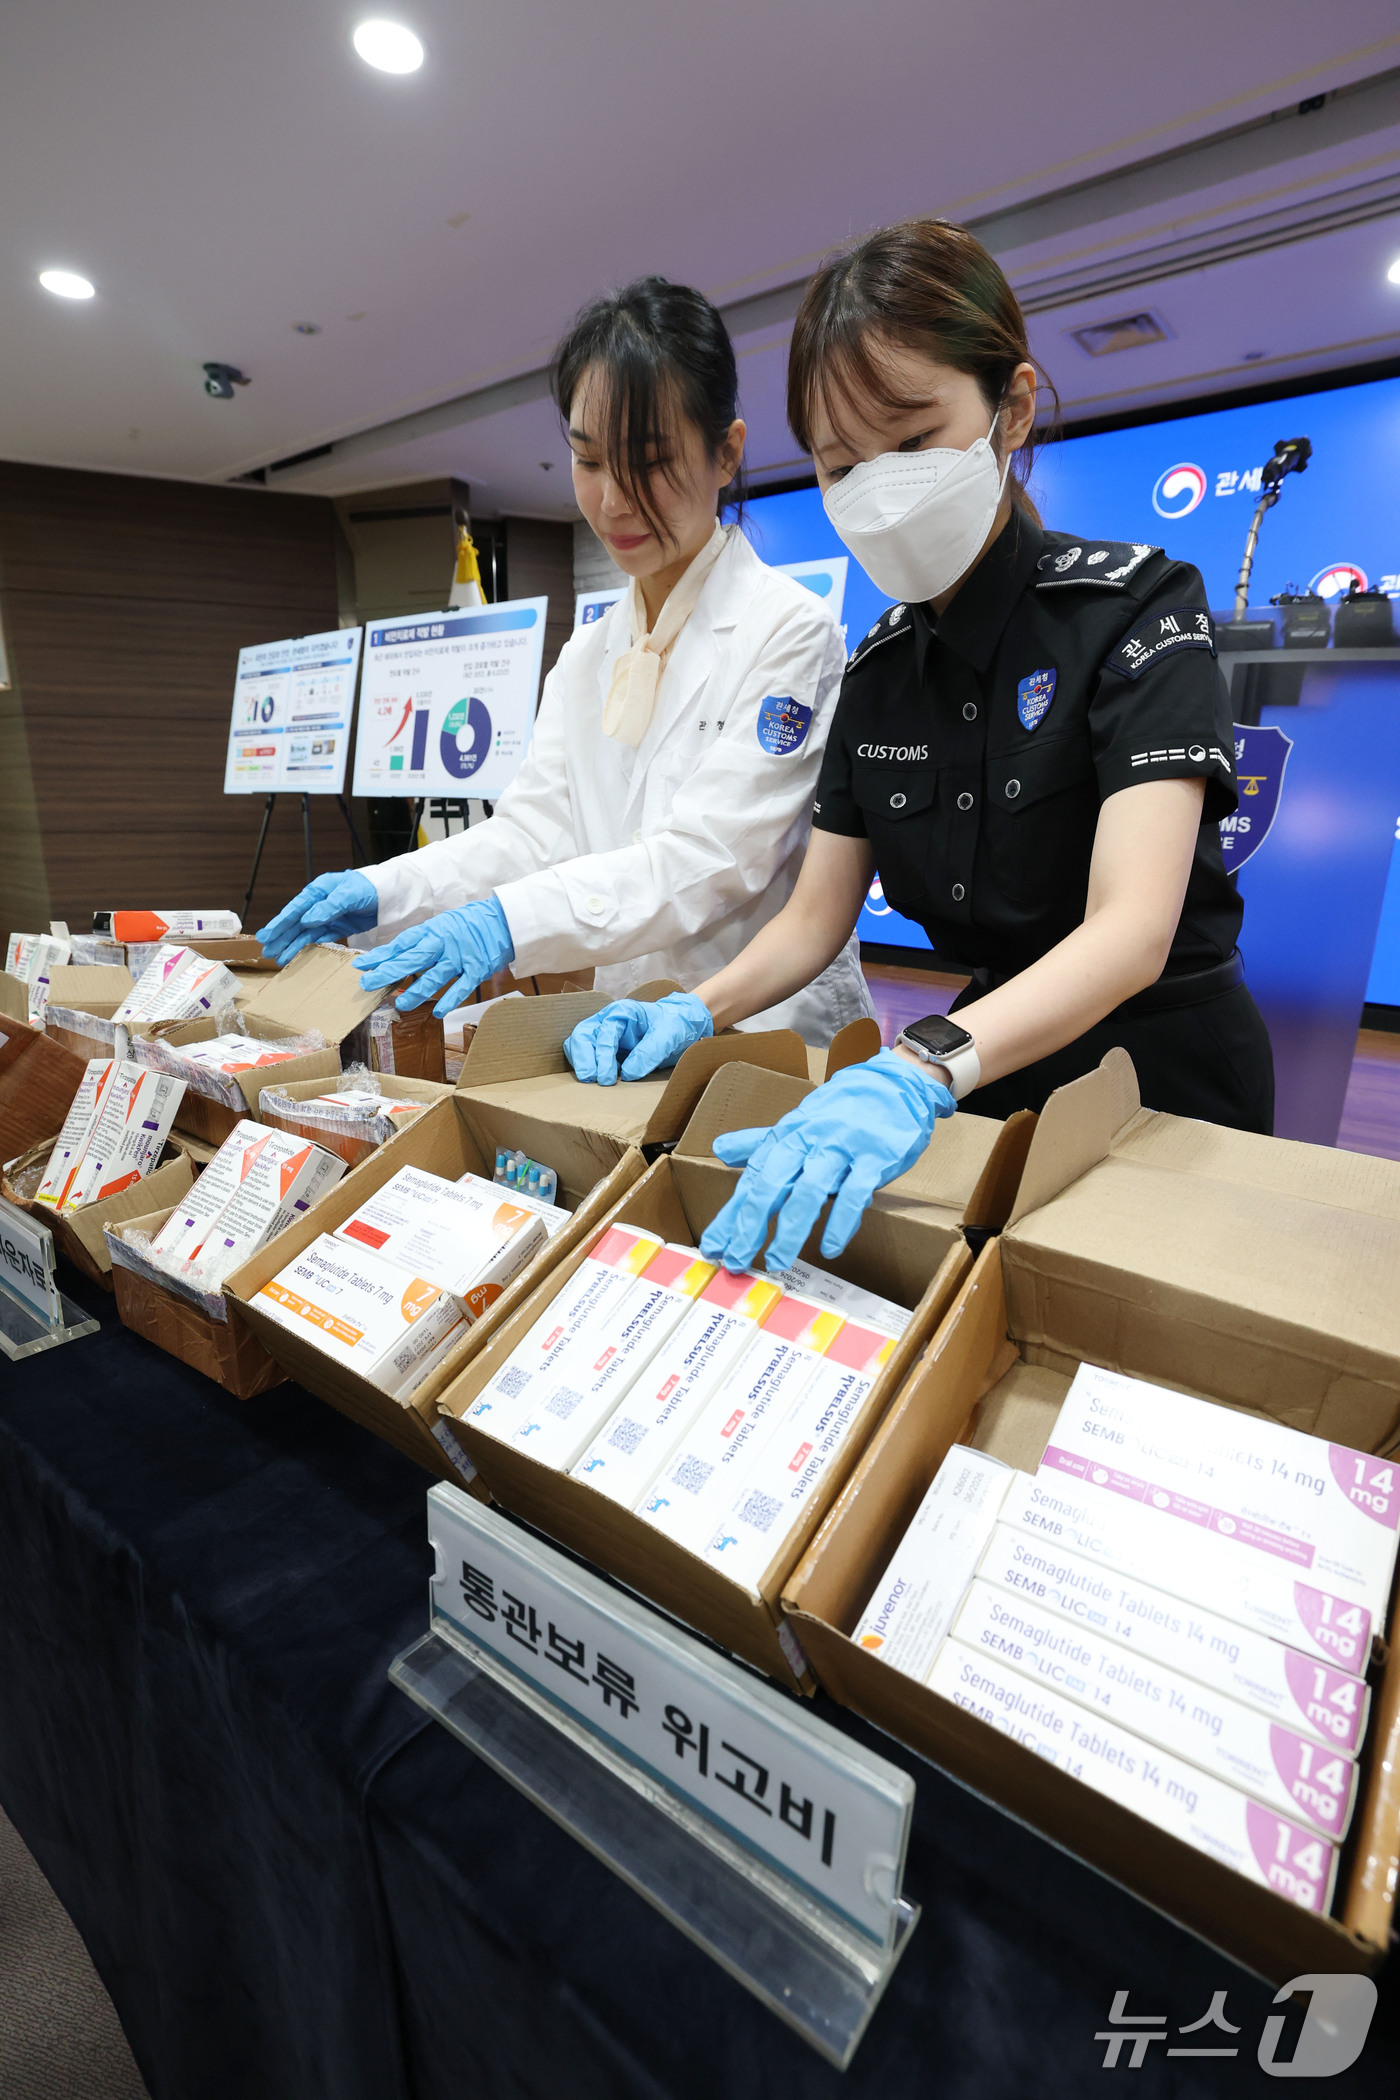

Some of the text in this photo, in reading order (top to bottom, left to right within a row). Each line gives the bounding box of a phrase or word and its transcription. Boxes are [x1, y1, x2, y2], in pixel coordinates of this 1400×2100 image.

[373, 633, 378, 644] 1
[1130, 649, 1156, 669] KOREA
[1155, 633, 1192, 650] CUSTOMS
[1029, 672, 1048, 686] 관세청
[776, 701, 799, 715] 관세청
[1022, 699, 1049, 715] CUSTOMS
[1027, 694, 1046, 706] KOREA
[1025, 708, 1045, 721] SERVICE
[763, 728, 797, 741] CUSTOMS
[769, 721, 794, 734] KOREA
[765, 736, 792, 747] SERVICE
[857, 744, 929, 761] CUSTOMS
[130, 1133, 146, 1158] KwikPen
[135, 1134, 154, 1165] mounjaro
[267, 1140, 296, 1156] Tirzepatide
[284, 1165, 294, 1173] mg
[399, 1172, 443, 1194] Semaglutide
[438, 1187, 468, 1203] Tablets
[462, 1196, 473, 1205] 7
[467, 1199, 484, 1210] mg
[505, 1209, 525, 1225] 7
[303, 1251, 395, 1305] Semaglutide Tablets 7 mg
[778, 1271, 806, 1287] 06/2026
[333, 1287, 343, 1296] 7
[414, 1286, 436, 1304] 7
[469, 1283, 487, 1305] mg
[568, 1269, 609, 1318] RYBELSUS
[400, 1301, 422, 1317] mg
[621, 1290, 663, 1339] RYBELSUS
[539, 1273, 619, 1372] Semaglutide Tablets
[546, 1334, 555, 1346] mg
[591, 1294, 674, 1393] Semaglutide Tablets
[684, 1313, 725, 1366] RYBELSUS
[598, 1355, 608, 1366] mg
[656, 1317, 737, 1425] Semaglutide Tablets
[748, 1345, 789, 1400] RYBELSUS
[660, 1384, 671, 1396] mg
[722, 1349, 802, 1464] Semaglutide Tablets
[815, 1375, 856, 1432] RYBELSUS
[724, 1419, 735, 1433] mg
[790, 1380, 870, 1500] Semaglutide Tablets
[792, 1453, 803, 1467] mg
[1058, 1455, 1085, 1472] Oral use
[951, 1467, 972, 1497] K26002
[963, 1470, 985, 1504] 06/2026
[1270, 1459, 1326, 1496] 14 mg
[1354, 1458, 1394, 1495] 14
[1350, 1487, 1389, 1514] mg
[870, 1575, 911, 1638] juvenor
[1012, 1544, 1240, 1665] Semaglutide Tablets 14 mg
[1320, 1595, 1363, 1636] 14
[1114, 1620, 1132, 1638] 14
[1314, 1625, 1357, 1658] mg
[989, 1602, 1092, 1666] Semaglutide
[1097, 1654, 1162, 1703] Tablets
[1168, 1690, 1186, 1714] 14
[1190, 1705, 1224, 1737] mg
[1093, 1687, 1112, 1706] 14
[1312, 1666, 1358, 1715] 14
[460, 1560, 835, 1868] 통관보류 위고비
[1306, 1701, 1351, 1738] mg
[960, 1664, 1199, 1814] Semaglutide Tablets 14 mg
[1063, 1757, 1084, 1779] 14
[1299, 1743, 1346, 1795] 14
[1293, 1779, 1339, 1821] mg
[1276, 1822, 1324, 1881] 14
[1267, 1864, 1316, 1909] mg
